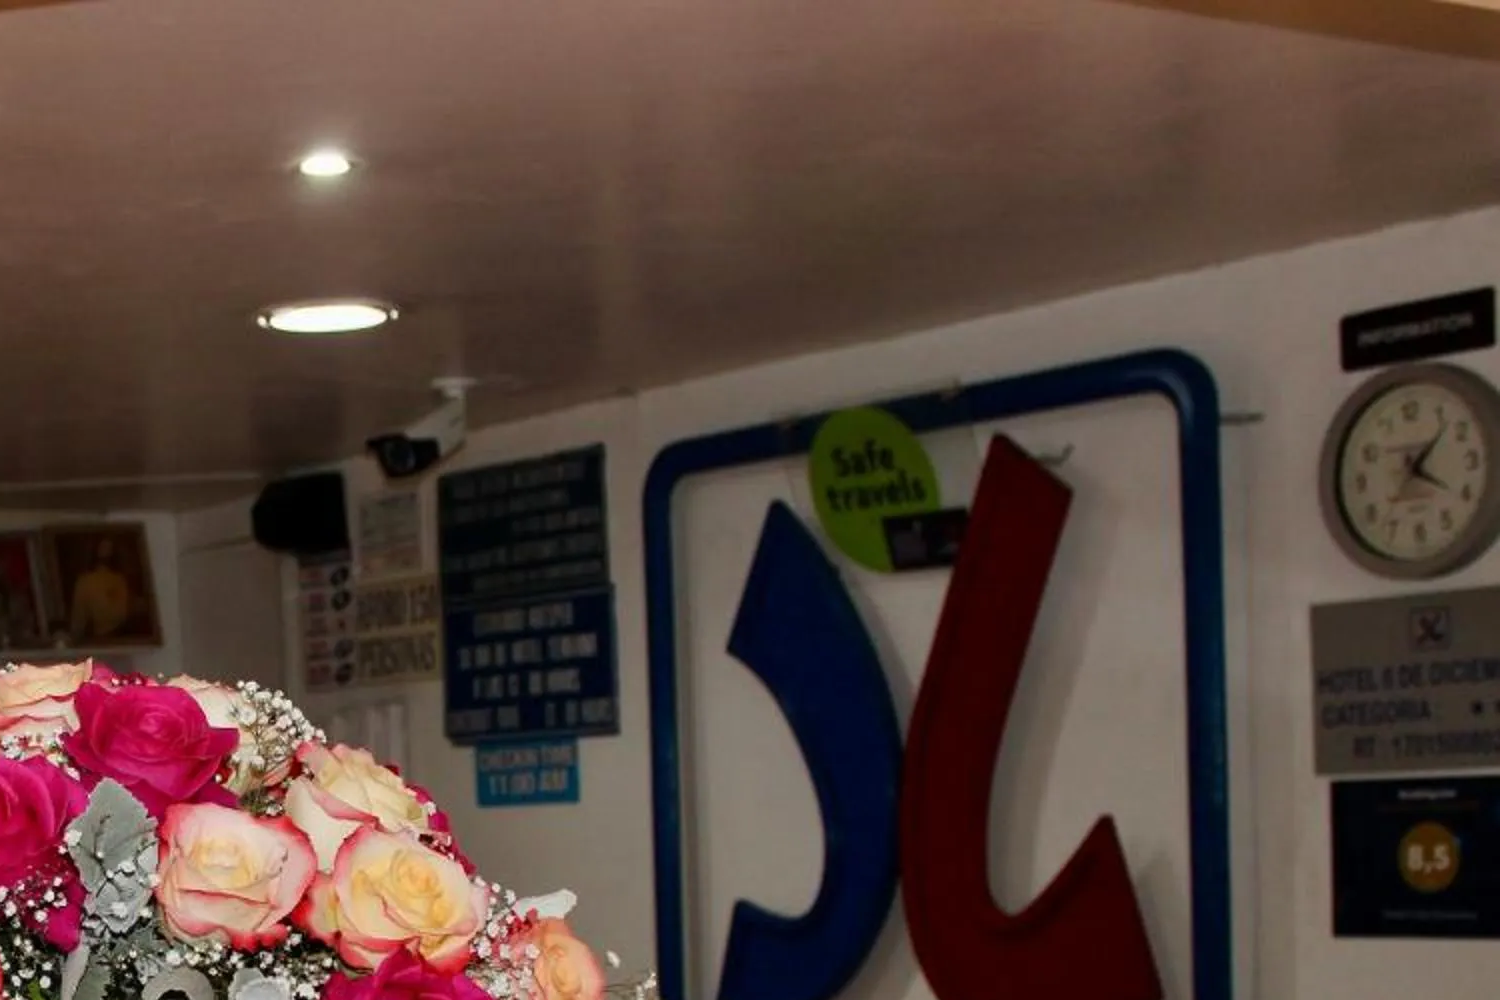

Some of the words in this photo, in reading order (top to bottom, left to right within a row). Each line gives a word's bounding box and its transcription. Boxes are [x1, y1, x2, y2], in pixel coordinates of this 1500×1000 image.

[831, 437, 894, 477] Safe
[825, 469, 927, 513] travels
[1318, 666, 1377, 693] HOTEL
[1398, 663, 1423, 688] DE
